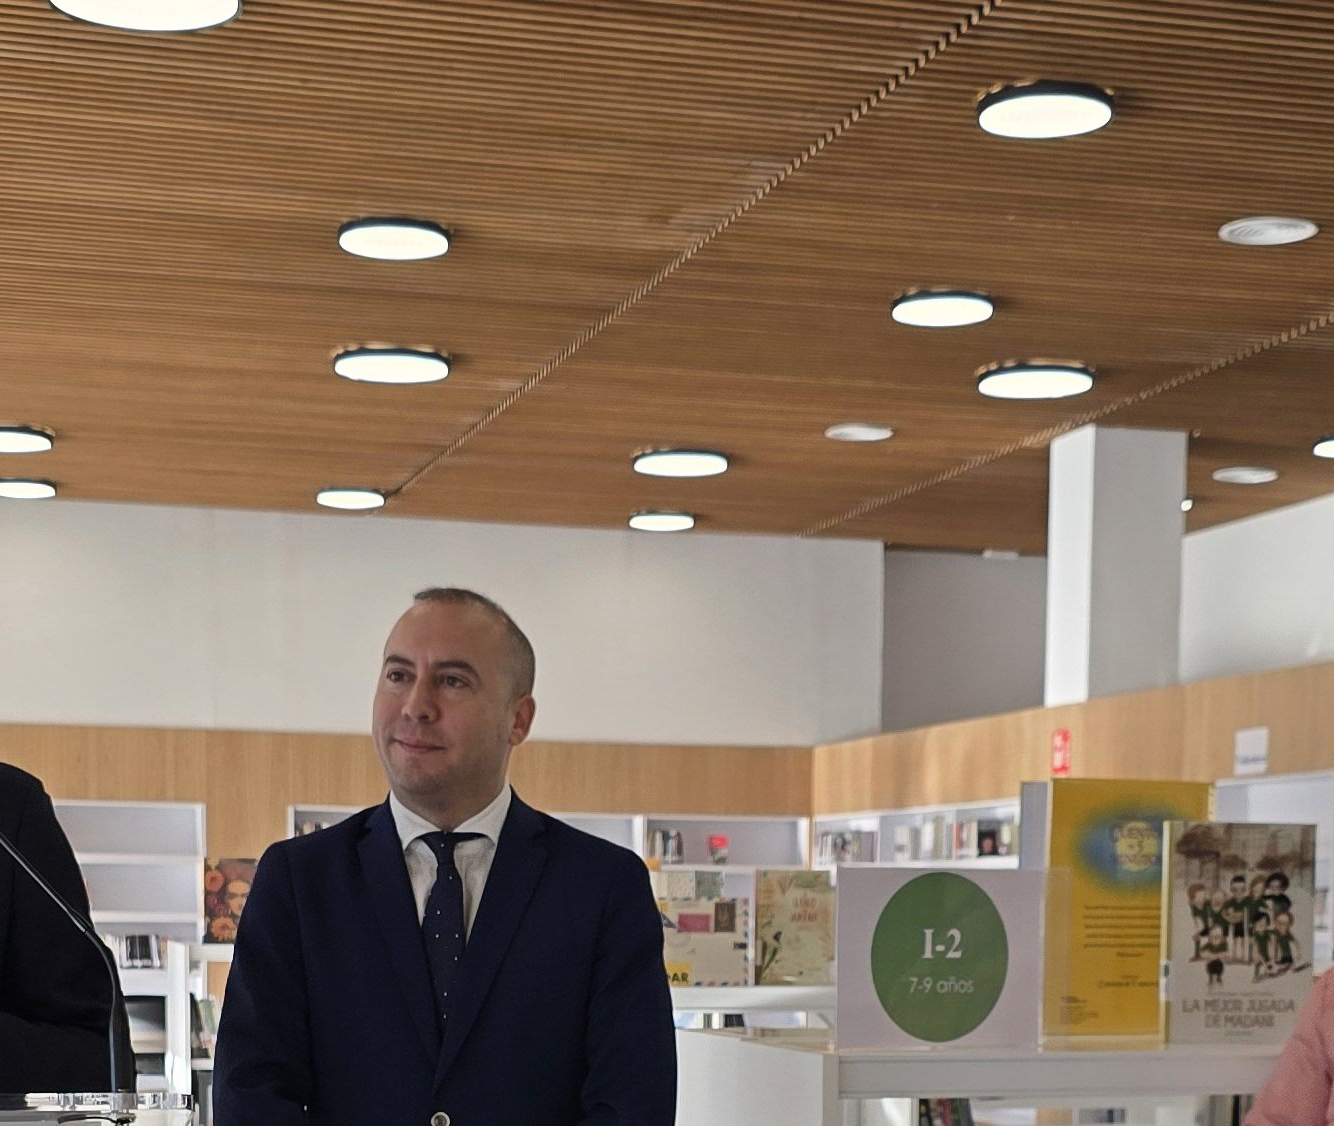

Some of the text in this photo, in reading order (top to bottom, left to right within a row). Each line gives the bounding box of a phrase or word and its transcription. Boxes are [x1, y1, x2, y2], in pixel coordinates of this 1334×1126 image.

[922, 928, 963, 959] I-2
[668, 972, 689, 983] AR
[909, 976, 974, 994] 7-9 años
